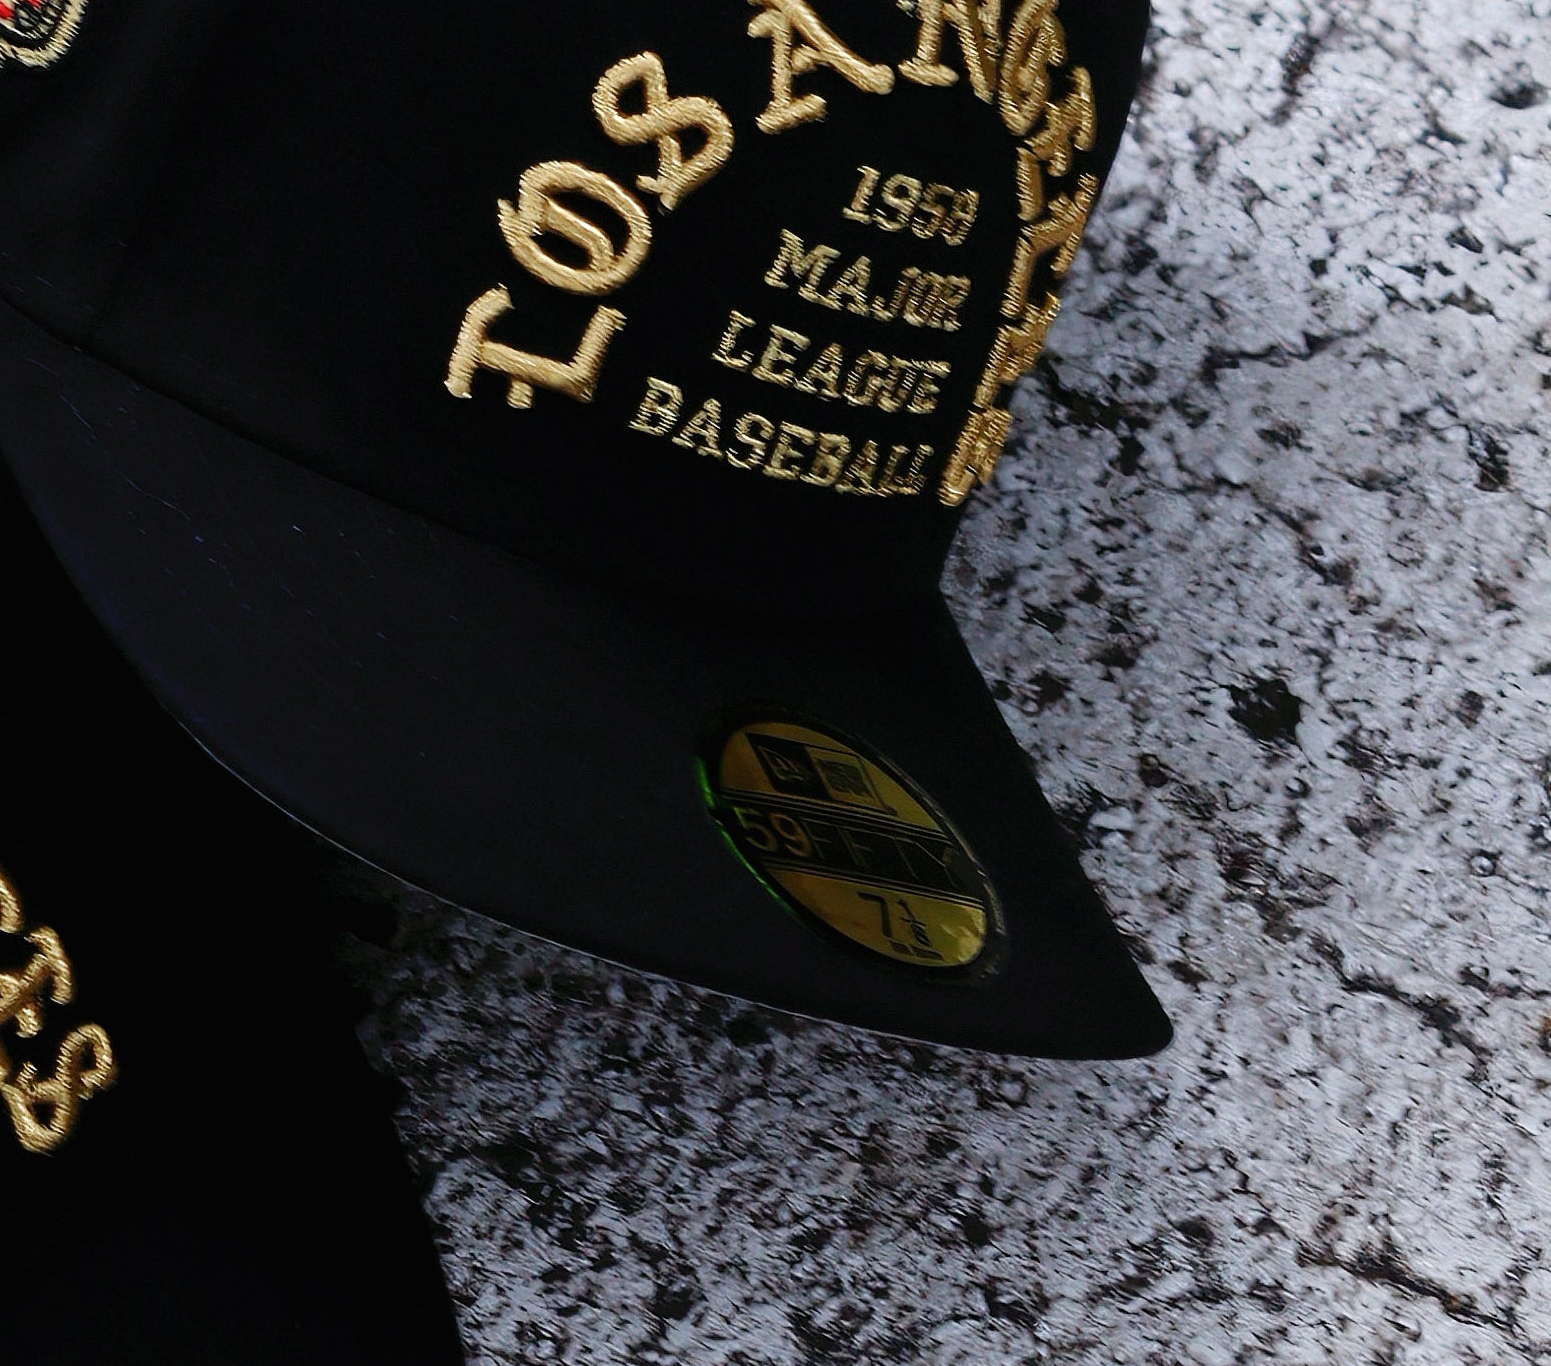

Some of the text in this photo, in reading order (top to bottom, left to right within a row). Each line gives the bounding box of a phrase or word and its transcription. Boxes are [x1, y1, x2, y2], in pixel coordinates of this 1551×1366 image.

[445, 52, 735, 410] LOS
[765, 229, 972, 332] MAJOR
[712, 310, 951, 415] LEAGUE
[630, 377, 935, 498] BASEBALL
